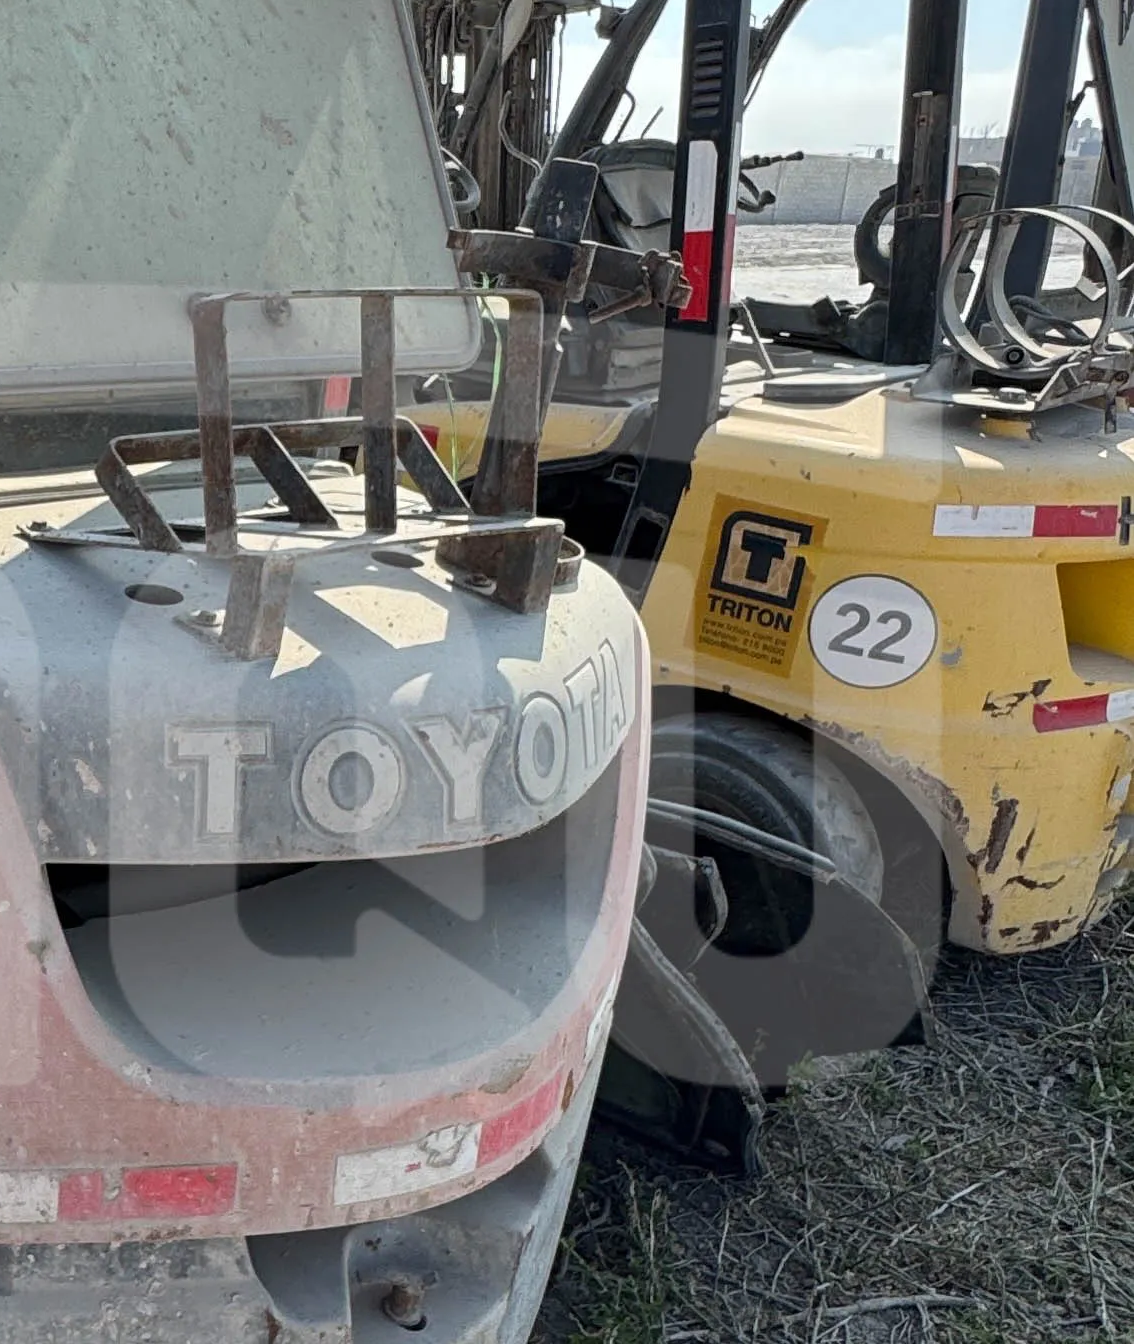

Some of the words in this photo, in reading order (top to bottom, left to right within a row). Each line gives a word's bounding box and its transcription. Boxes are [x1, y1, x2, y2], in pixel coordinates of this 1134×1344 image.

[708, 593, 793, 633] TRITON
[827, 602, 912, 665] 22
[165, 639, 627, 843] TOYOTA
